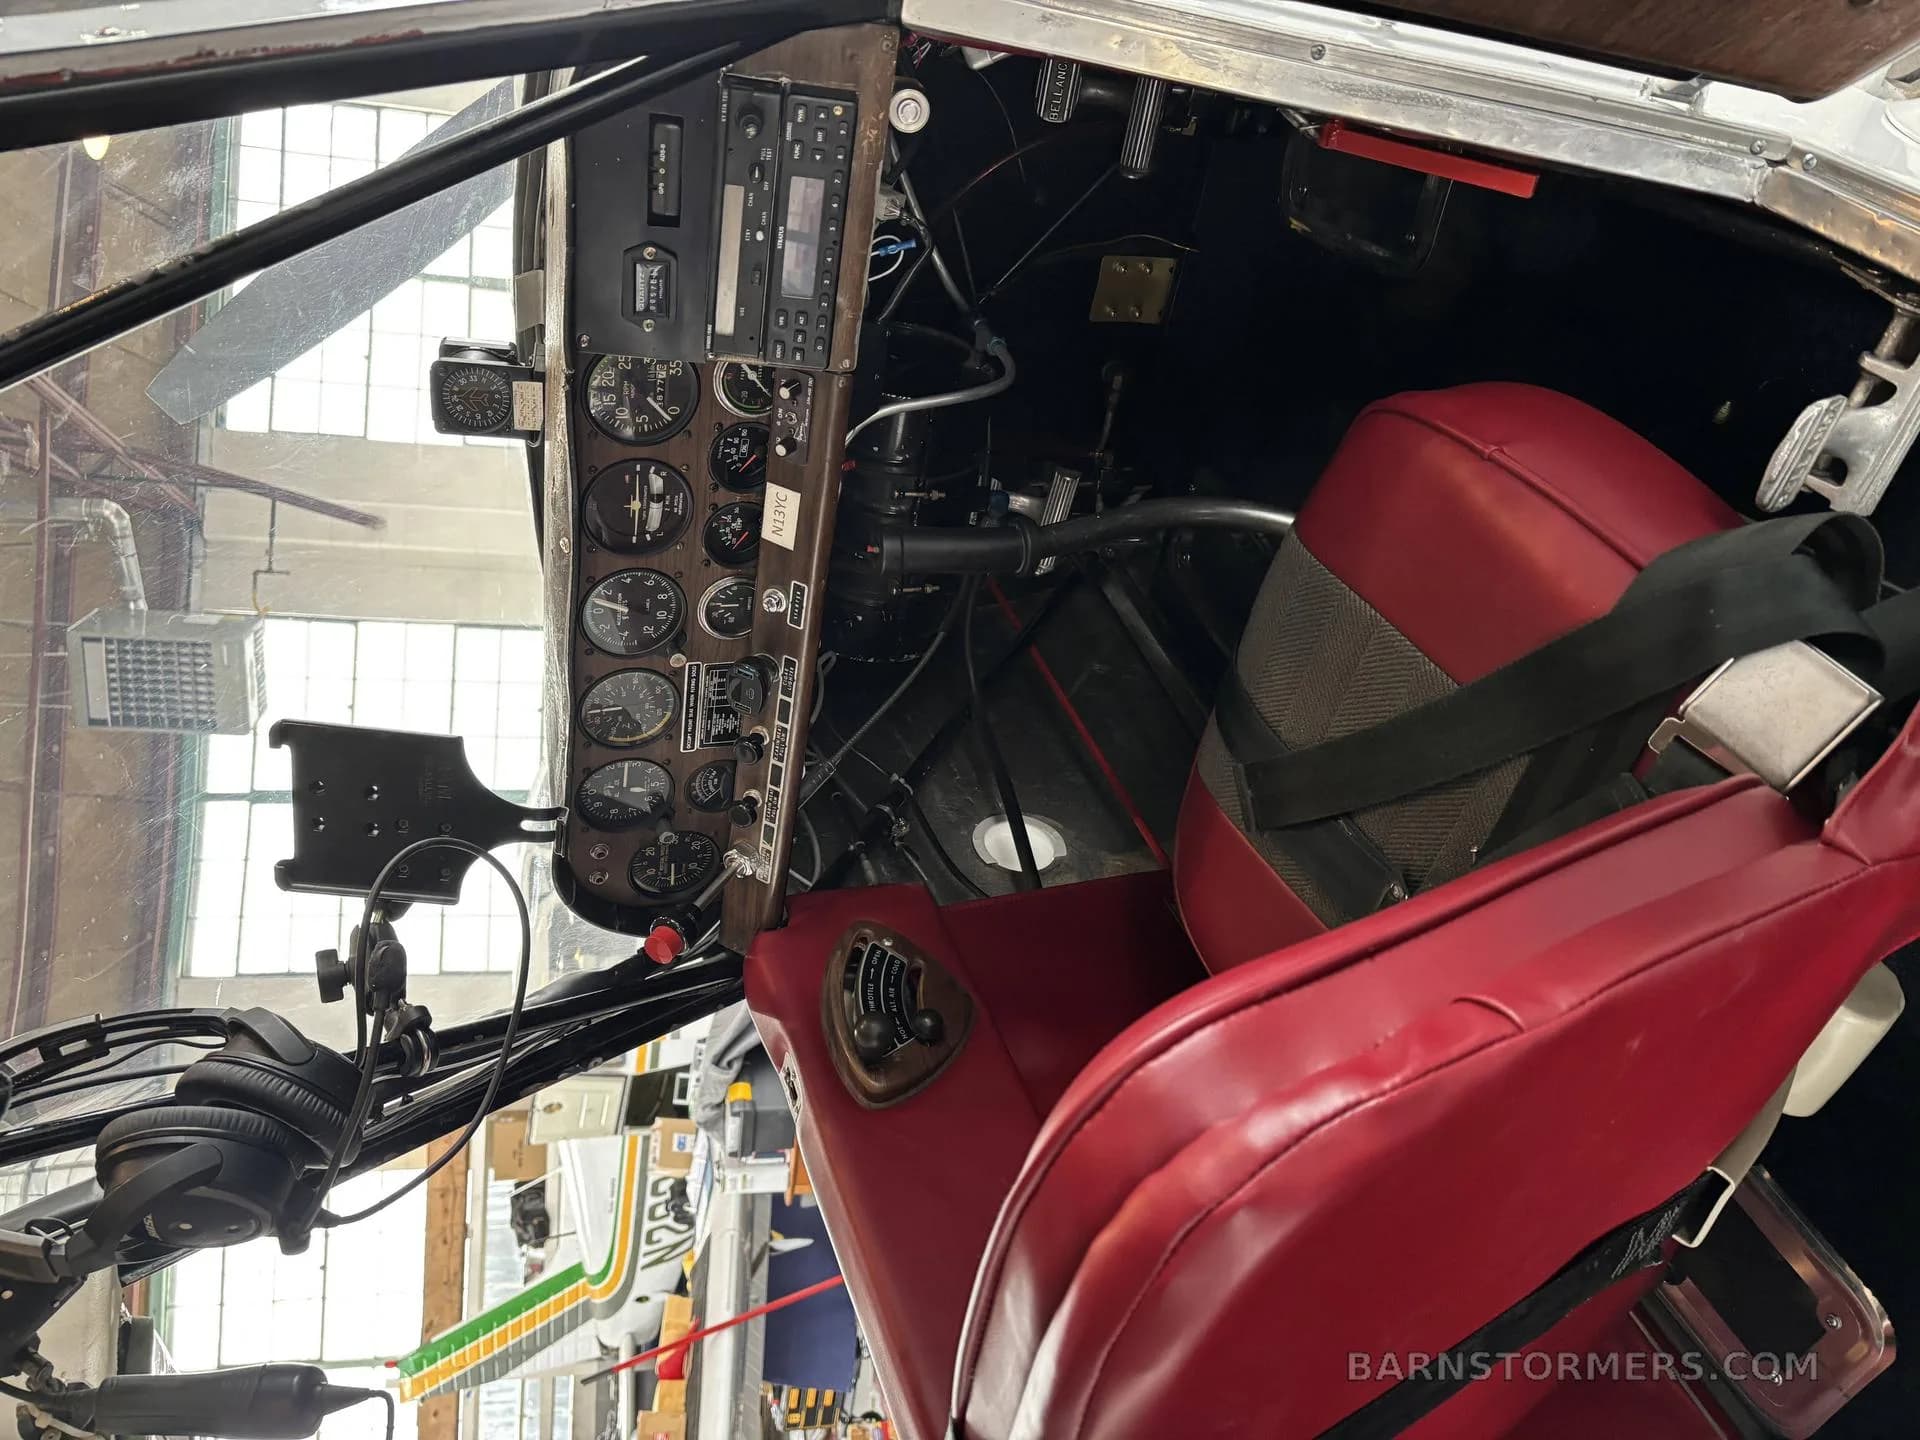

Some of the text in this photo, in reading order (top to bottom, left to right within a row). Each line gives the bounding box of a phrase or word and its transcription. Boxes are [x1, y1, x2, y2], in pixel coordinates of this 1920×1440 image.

[1048, 63, 1068, 120] BELLANC
[793, 143, 801, 159] FUNC
[777, 225, 785, 249] STRATUS
[619, 355, 631, 370] 25
[669, 360, 682, 376] 35
[602, 371, 615, 387] 20
[604, 394, 616, 405] 15
[616, 407, 629, 419] 10
[668, 406, 680, 415] 0
[636, 415, 648, 423] 5
[771, 491, 788, 537] N13YC
[793, 591, 801, 620] STARTER
[656, 610, 667, 620] 10
[599, 624, 610, 632] -2
[643, 625, 654, 634] 12
[619, 631, 629, 640] -4
[781, 732, 786, 741] ON
[773, 796, 777, 804] ON
[691, 840, 701, 850] 20
[645, 847, 655, 856] 20
[891, 959, 901, 975] COLD
[867, 949, 882, 1012] THROTTLE OPEN
[898, 1026, 908, 1039] HOT
